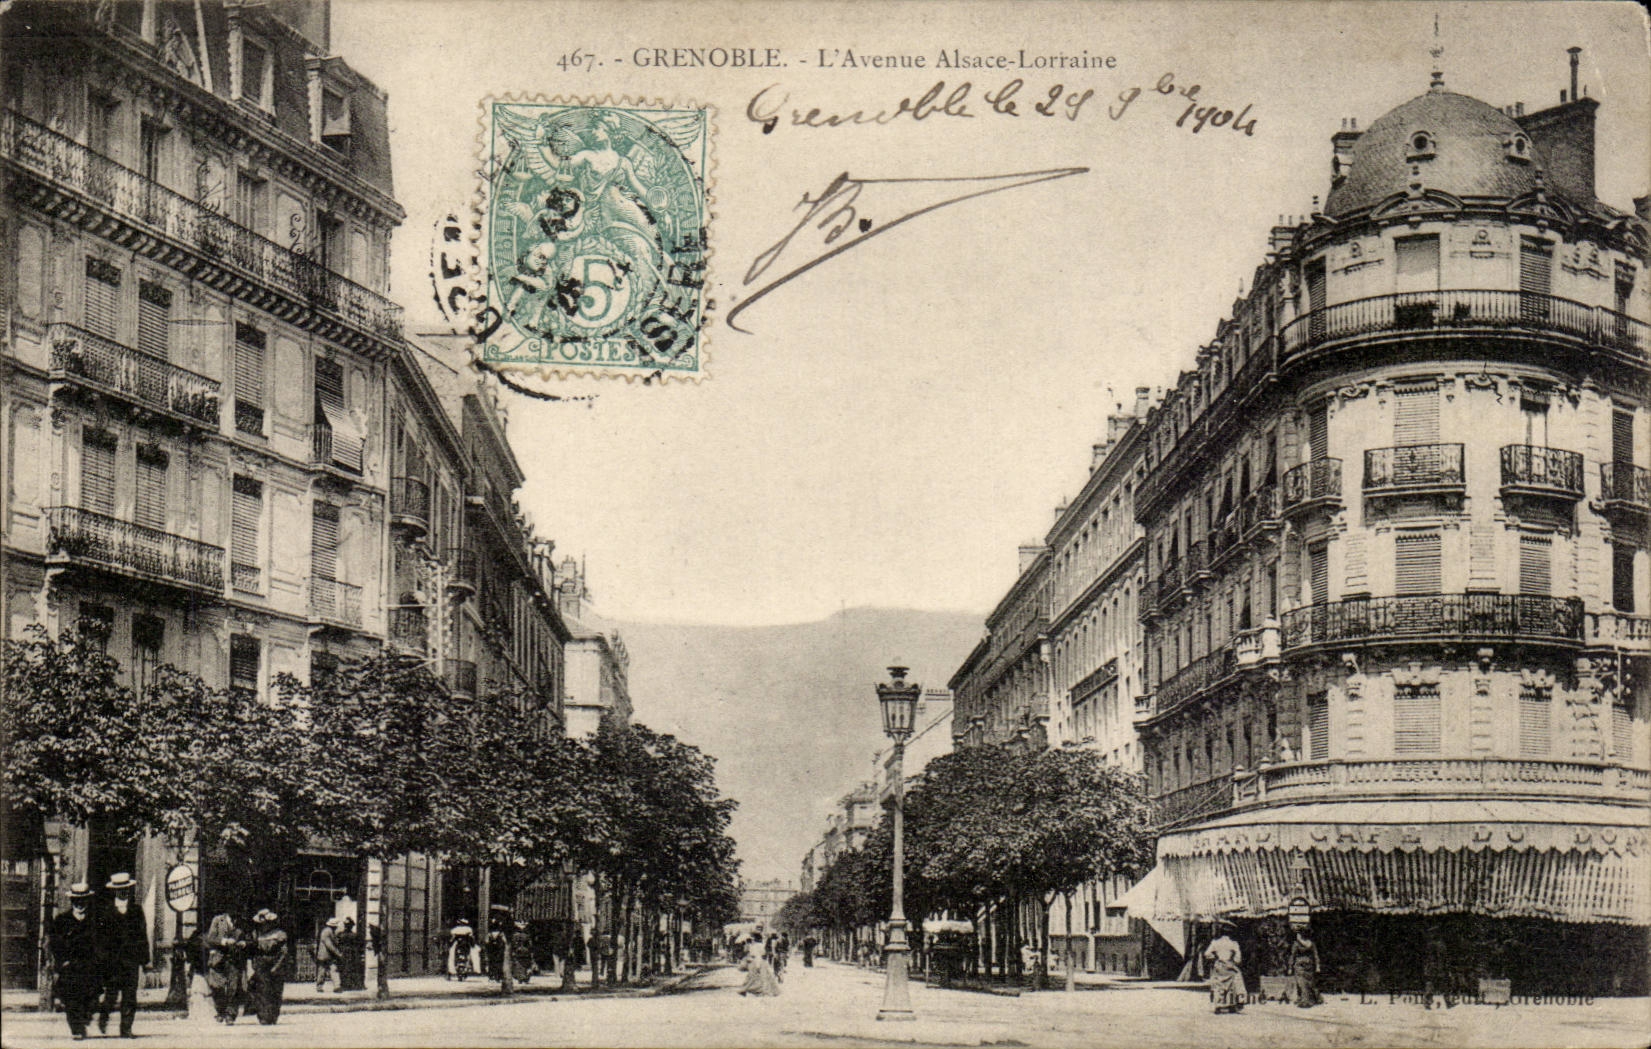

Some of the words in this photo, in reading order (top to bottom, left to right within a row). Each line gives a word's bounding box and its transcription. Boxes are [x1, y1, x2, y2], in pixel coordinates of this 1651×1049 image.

[747, 82, 974, 134] Grenoble
[984, 79, 1021, 117] le
[1175, 102, 1258, 136] 1904
[547, 341, 637, 361] POSTES
